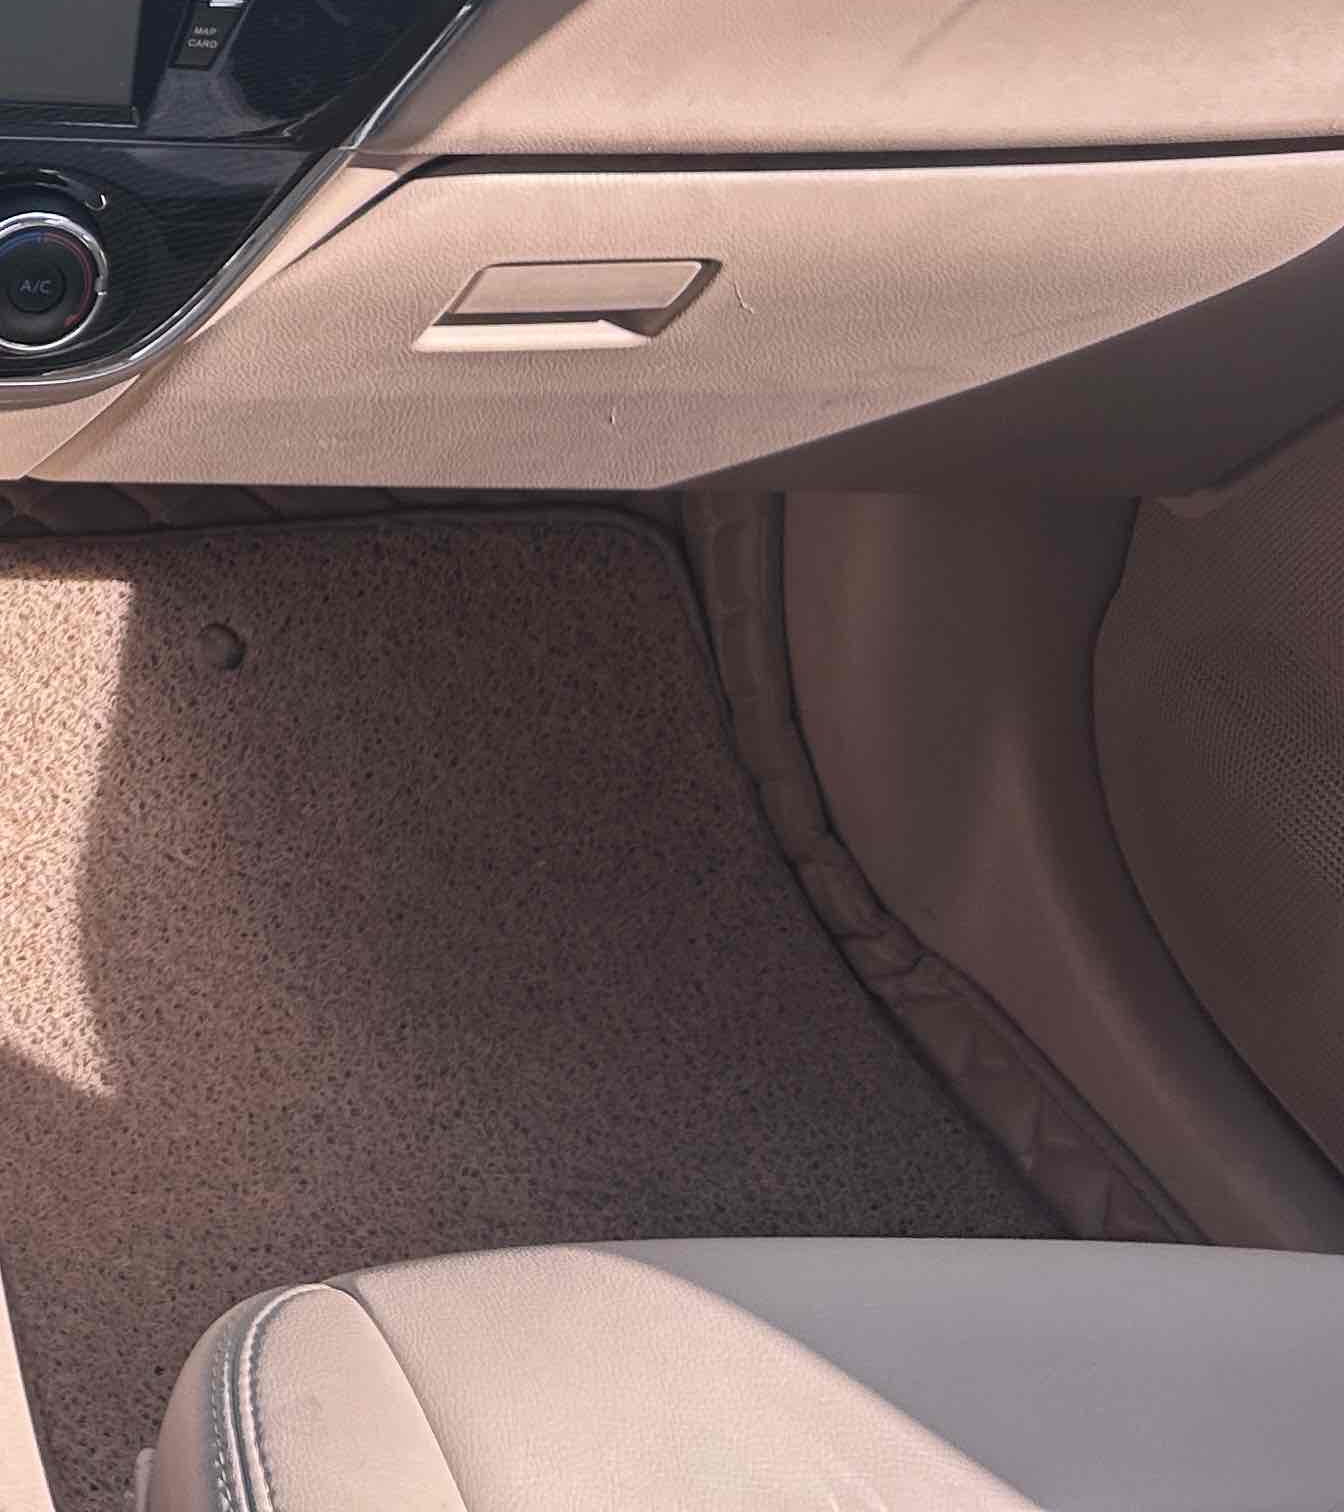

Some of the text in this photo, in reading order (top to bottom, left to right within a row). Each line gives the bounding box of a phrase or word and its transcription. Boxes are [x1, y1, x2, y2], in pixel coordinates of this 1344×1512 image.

[193, 25, 217, 36] MAP
[186, 38, 219, 49] CARD
[19, 279, 50, 295] A/C
